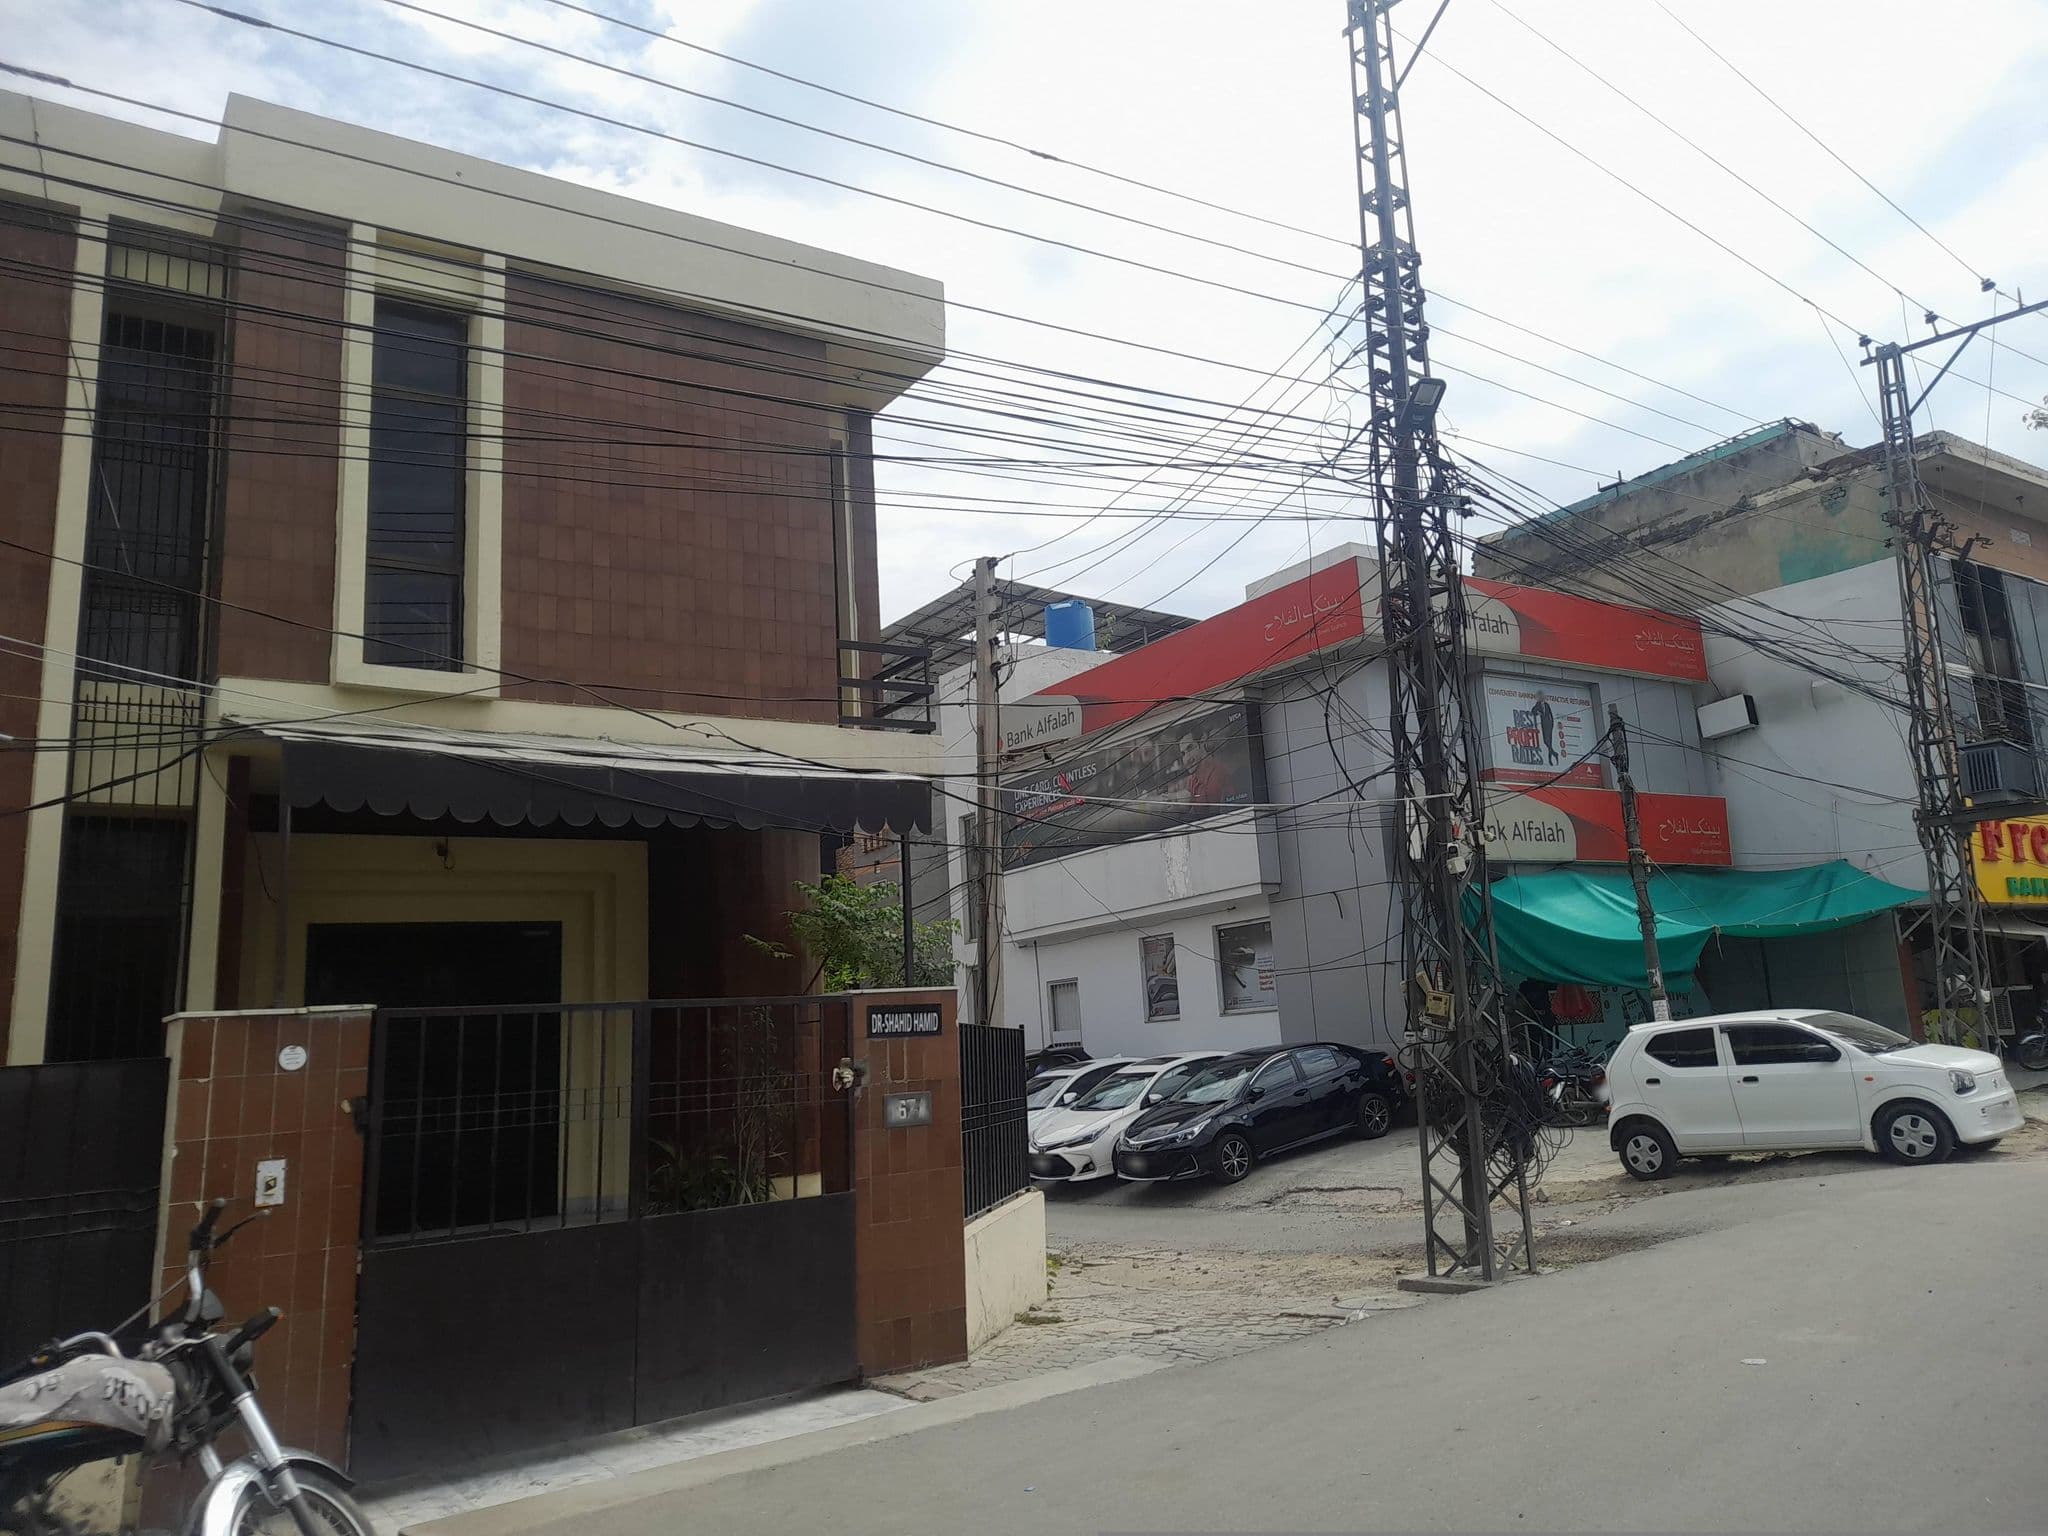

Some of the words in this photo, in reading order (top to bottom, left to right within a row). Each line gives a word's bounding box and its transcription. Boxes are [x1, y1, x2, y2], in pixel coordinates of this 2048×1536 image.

[1464, 608, 1509, 635] lfalah
[1006, 724, 1034, 748] Bank
[1036, 707, 1075, 735] Alfalah
[1513, 709, 1538, 729] BEST
[1506, 727, 1540, 748] PROFIT
[1511, 744, 1544, 766] RATES
[1014, 784, 1029, 801] ONE
[1014, 788, 1062, 814] EXPERIENCES
[1486, 821, 1508, 842] nk
[1512, 820, 1566, 843] Alfalah
[1659, 816, 1690, 842] الفلاح
[913, 1012, 939, 1032] HAMID
